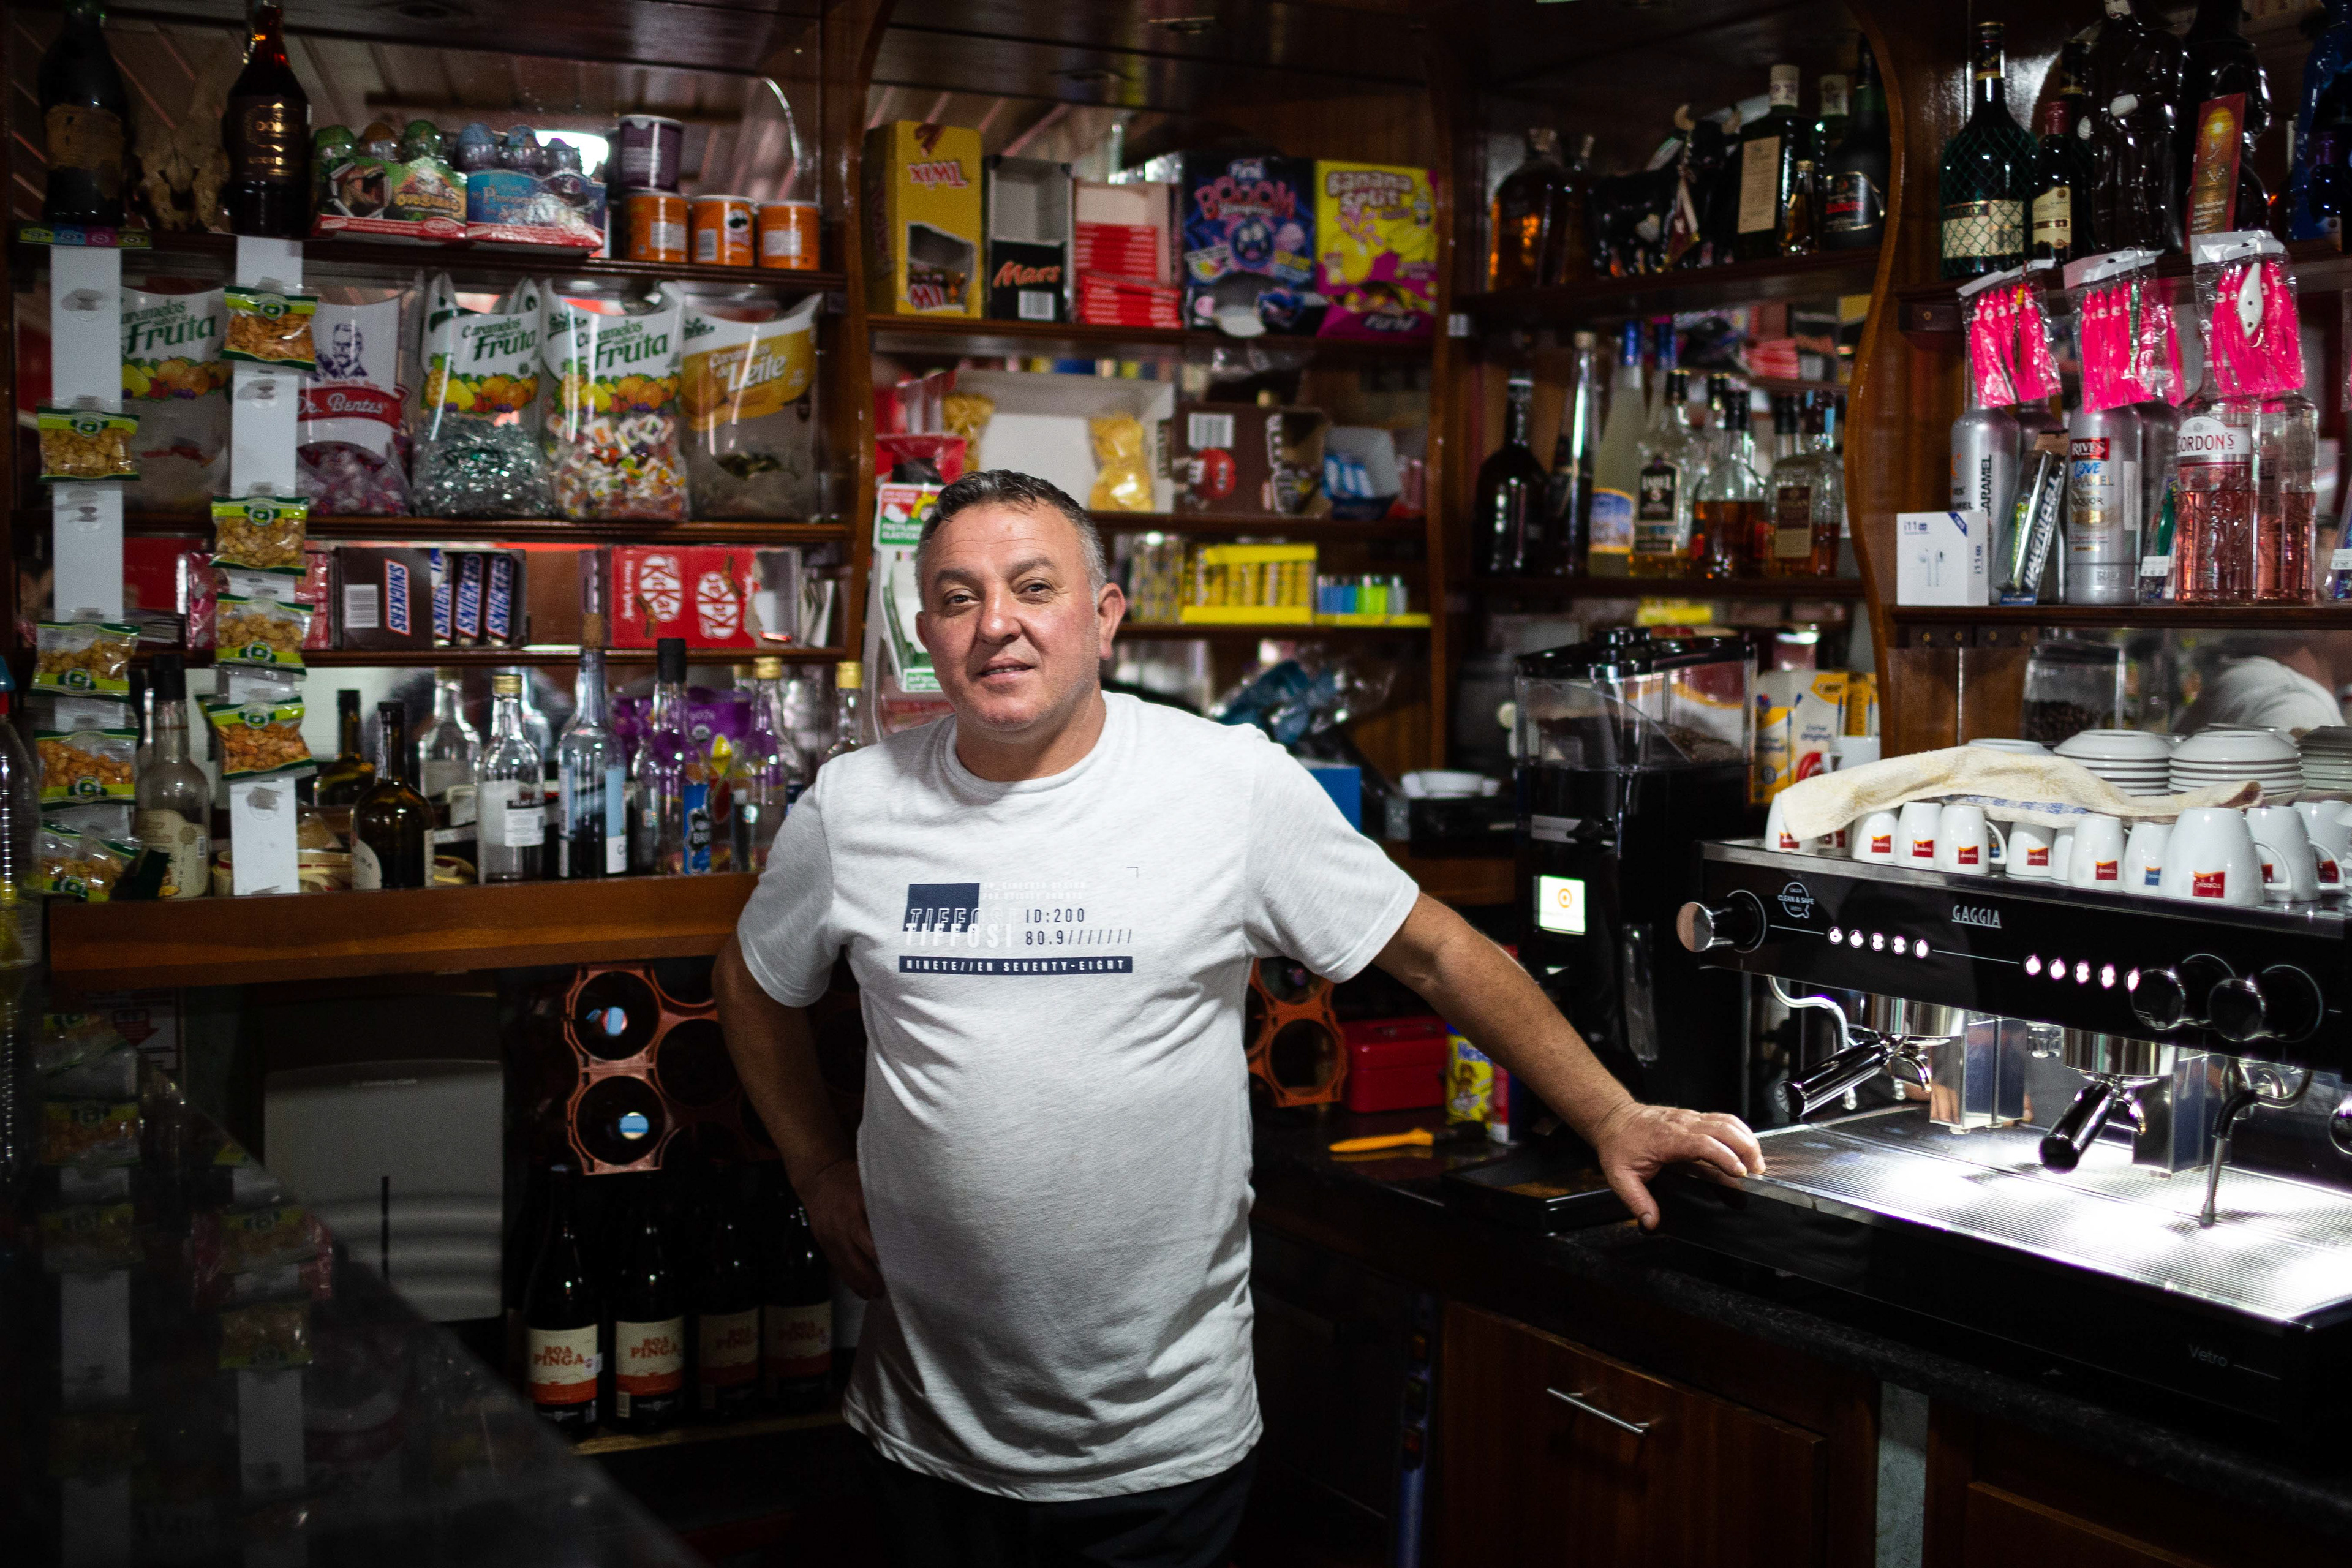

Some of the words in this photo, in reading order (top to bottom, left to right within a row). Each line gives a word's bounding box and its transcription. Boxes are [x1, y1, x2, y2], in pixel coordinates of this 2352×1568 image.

[908, 160, 968, 190] Twix
[992, 260, 1061, 288] Mars
[127, 315, 216, 355] Fruta
[473, 329, 537, 361] Fruta
[595, 333, 668, 371] Fruta
[388, 562, 407, 633] SNICKERS
[910, 908, 1016, 932] TIFFOSI
[1026, 908, 1084, 923] ID:200
[1952, 905, 2002, 927] GAGGIA
[905, 923, 1012, 948] TIFFOSI
[1003, 960, 1124, 972] SEVENTY-EIGHT
[545, 1346, 573, 1356] BOA
[630, 1343, 677, 1359] PINGA
[642, 1336, 670, 1348] BOA
[533, 1353, 584, 1366] PINGA
[2188, 1344, 2228, 1367] Vetro
